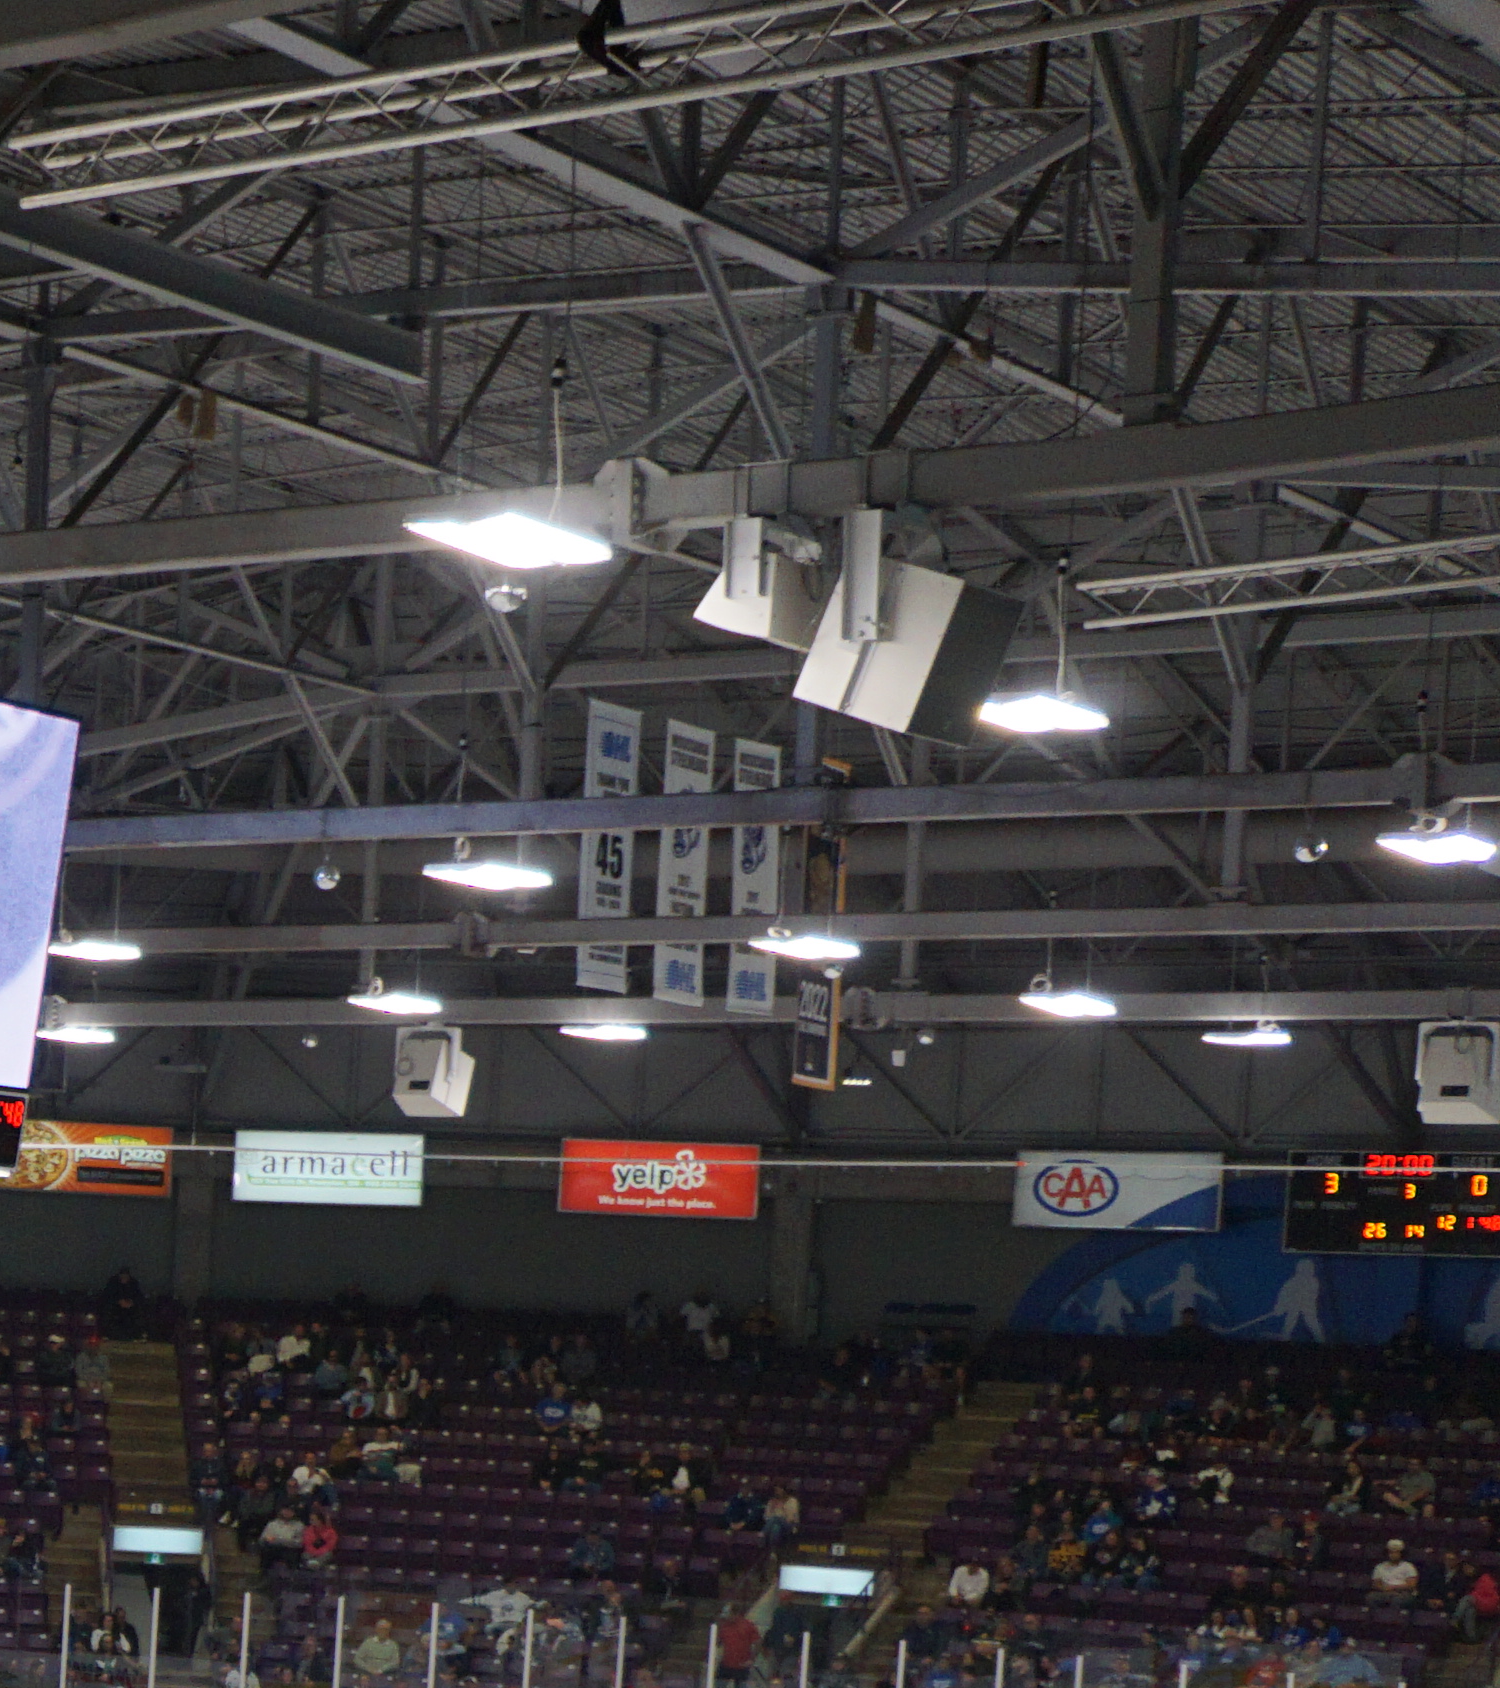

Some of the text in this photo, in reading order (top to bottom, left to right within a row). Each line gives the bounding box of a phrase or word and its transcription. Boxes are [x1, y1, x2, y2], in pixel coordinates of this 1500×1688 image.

[261, 1150, 410, 1177] armacell
[1365, 1154, 1435, 1177] 20:00
[615, 1162, 675, 1190] yelp
[1325, 1173, 1340, 1195] 3
[1470, 1174, 1489, 1197] 0
[1043, 1166, 1107, 1209] CAA
[1405, 1183, 1417, 1200] 3
[598, 1195, 615, 1205] We
[664, 1198, 684, 1208] the
[1362, 1222, 1387, 1239] 26
[1437, 1215, 1457, 1231] 12
